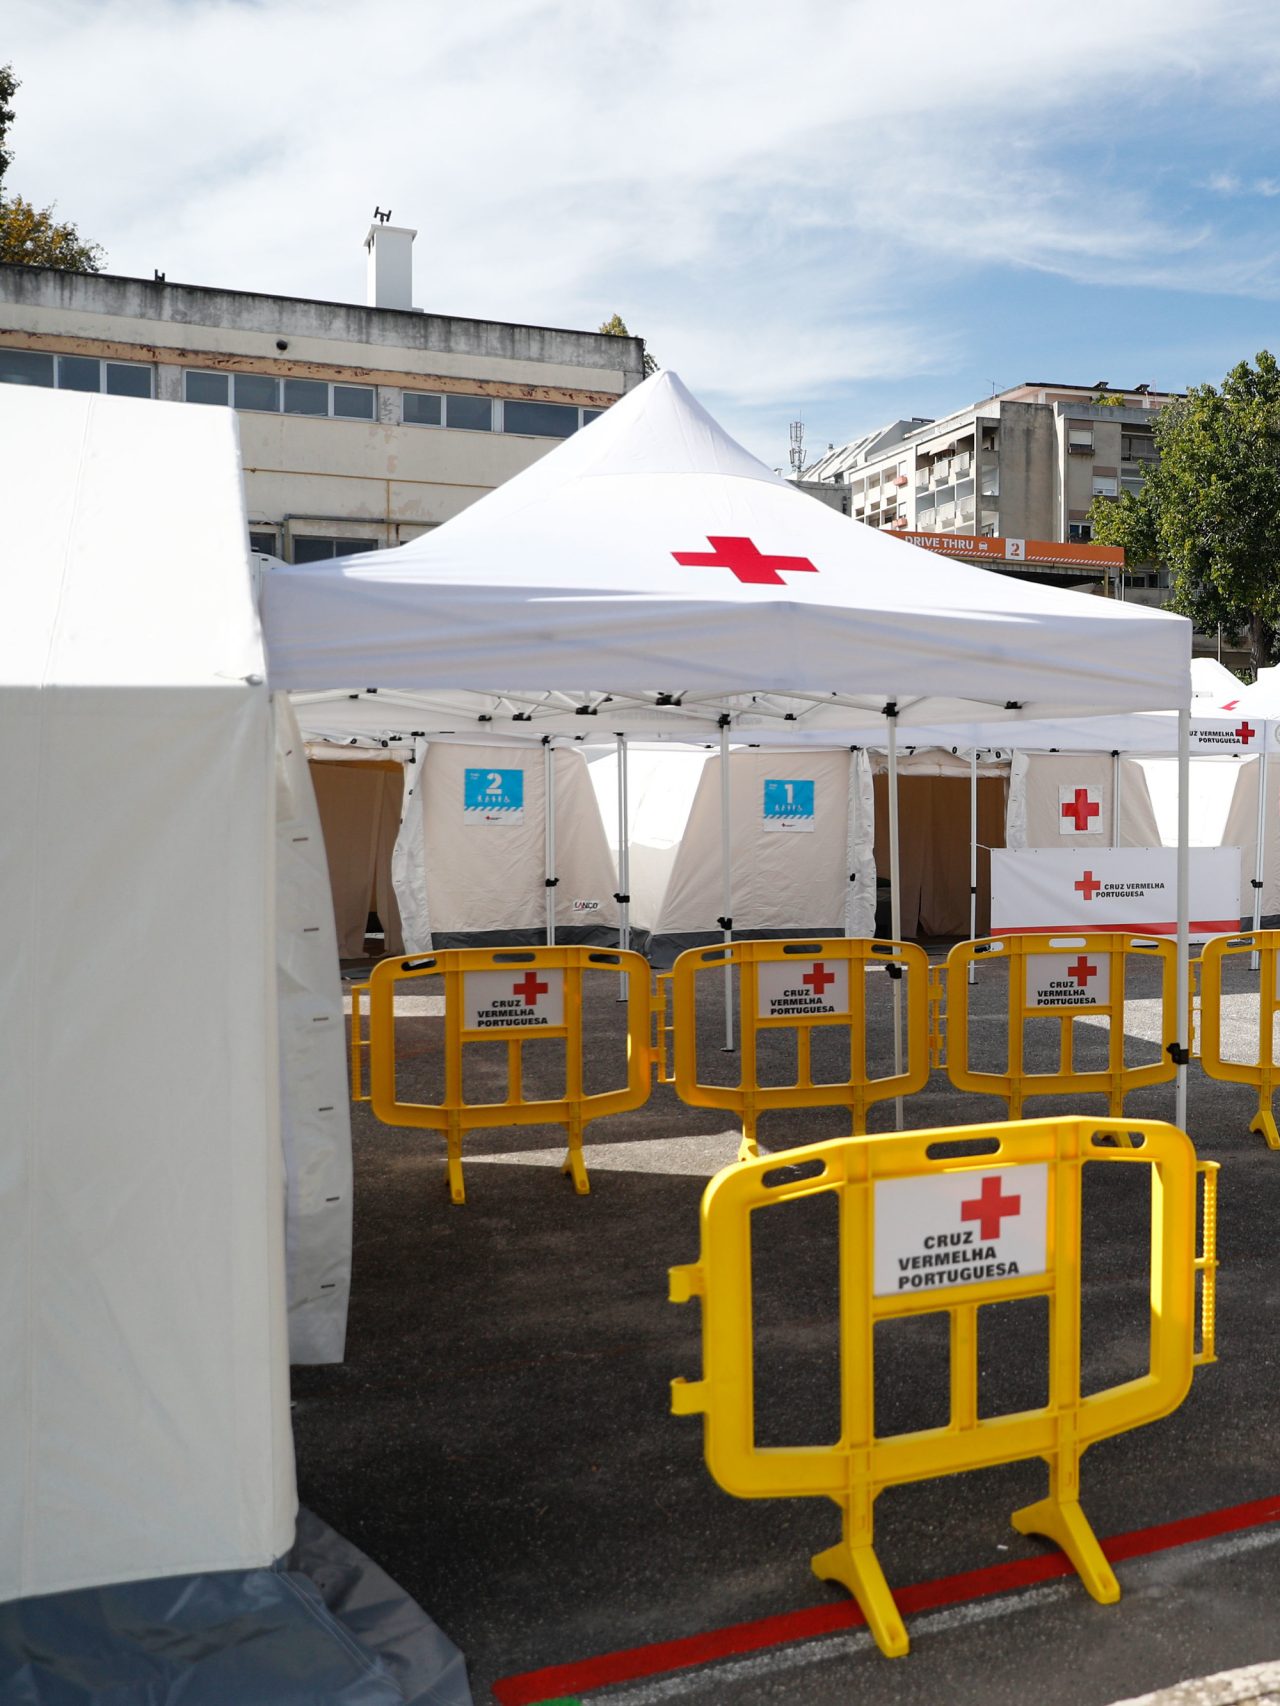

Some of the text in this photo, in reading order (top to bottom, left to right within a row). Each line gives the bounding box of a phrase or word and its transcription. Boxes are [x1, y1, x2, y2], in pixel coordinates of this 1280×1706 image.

[905, 536, 973, 549] DRIVE THRU
[1011, 543, 1019, 556] 2
[486, 773, 502, 794] 2
[784, 784, 793, 803] 1
[784, 989, 810, 997] CRUZ
[1037, 989, 1085, 997] VERMELHA
[492, 1000, 521, 1008] CRUZ
[770, 997, 823, 1006] VERMELHA
[1037, 997, 1096, 1005] PORTUGUESA
[477, 1009, 535, 1018] VERMELHA
[770, 1006, 835, 1015] PORTUGUESA
[477, 1017, 548, 1027] PORTUGUESA
[924, 1231, 973, 1250] CRUZ
[898, 1246, 997, 1271] VERMELHA
[898, 1261, 1020, 1289] PORTUGUESA
